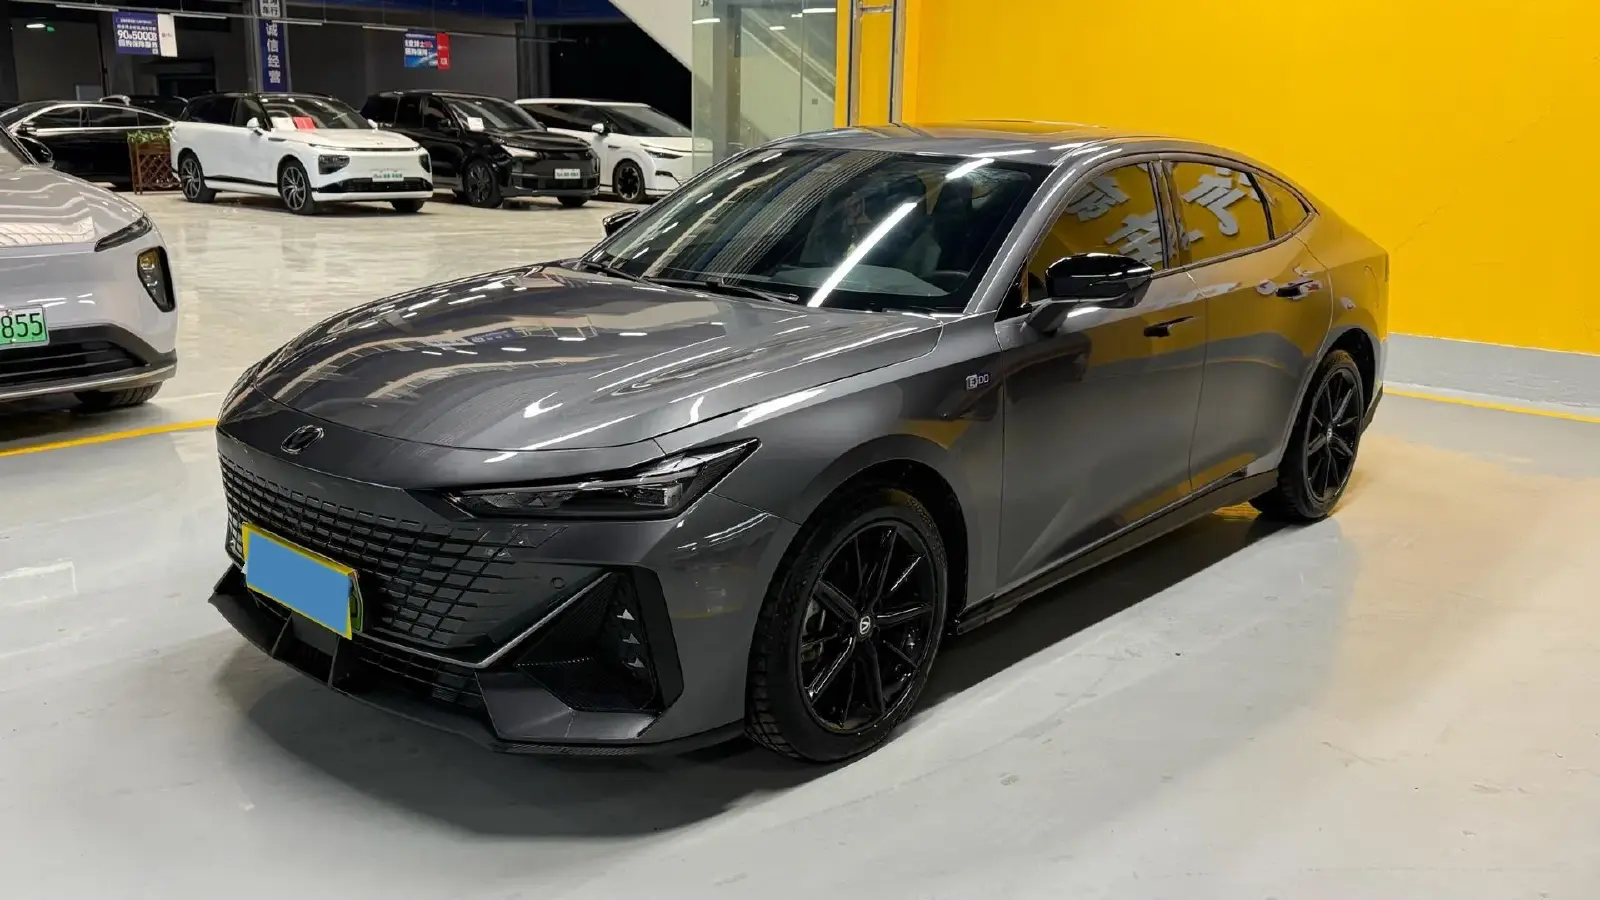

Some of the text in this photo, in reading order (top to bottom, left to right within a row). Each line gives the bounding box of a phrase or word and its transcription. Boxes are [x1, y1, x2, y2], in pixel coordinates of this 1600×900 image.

[266, 22, 281, 83] 诚信经营
[1, 313, 43, 338] 855
